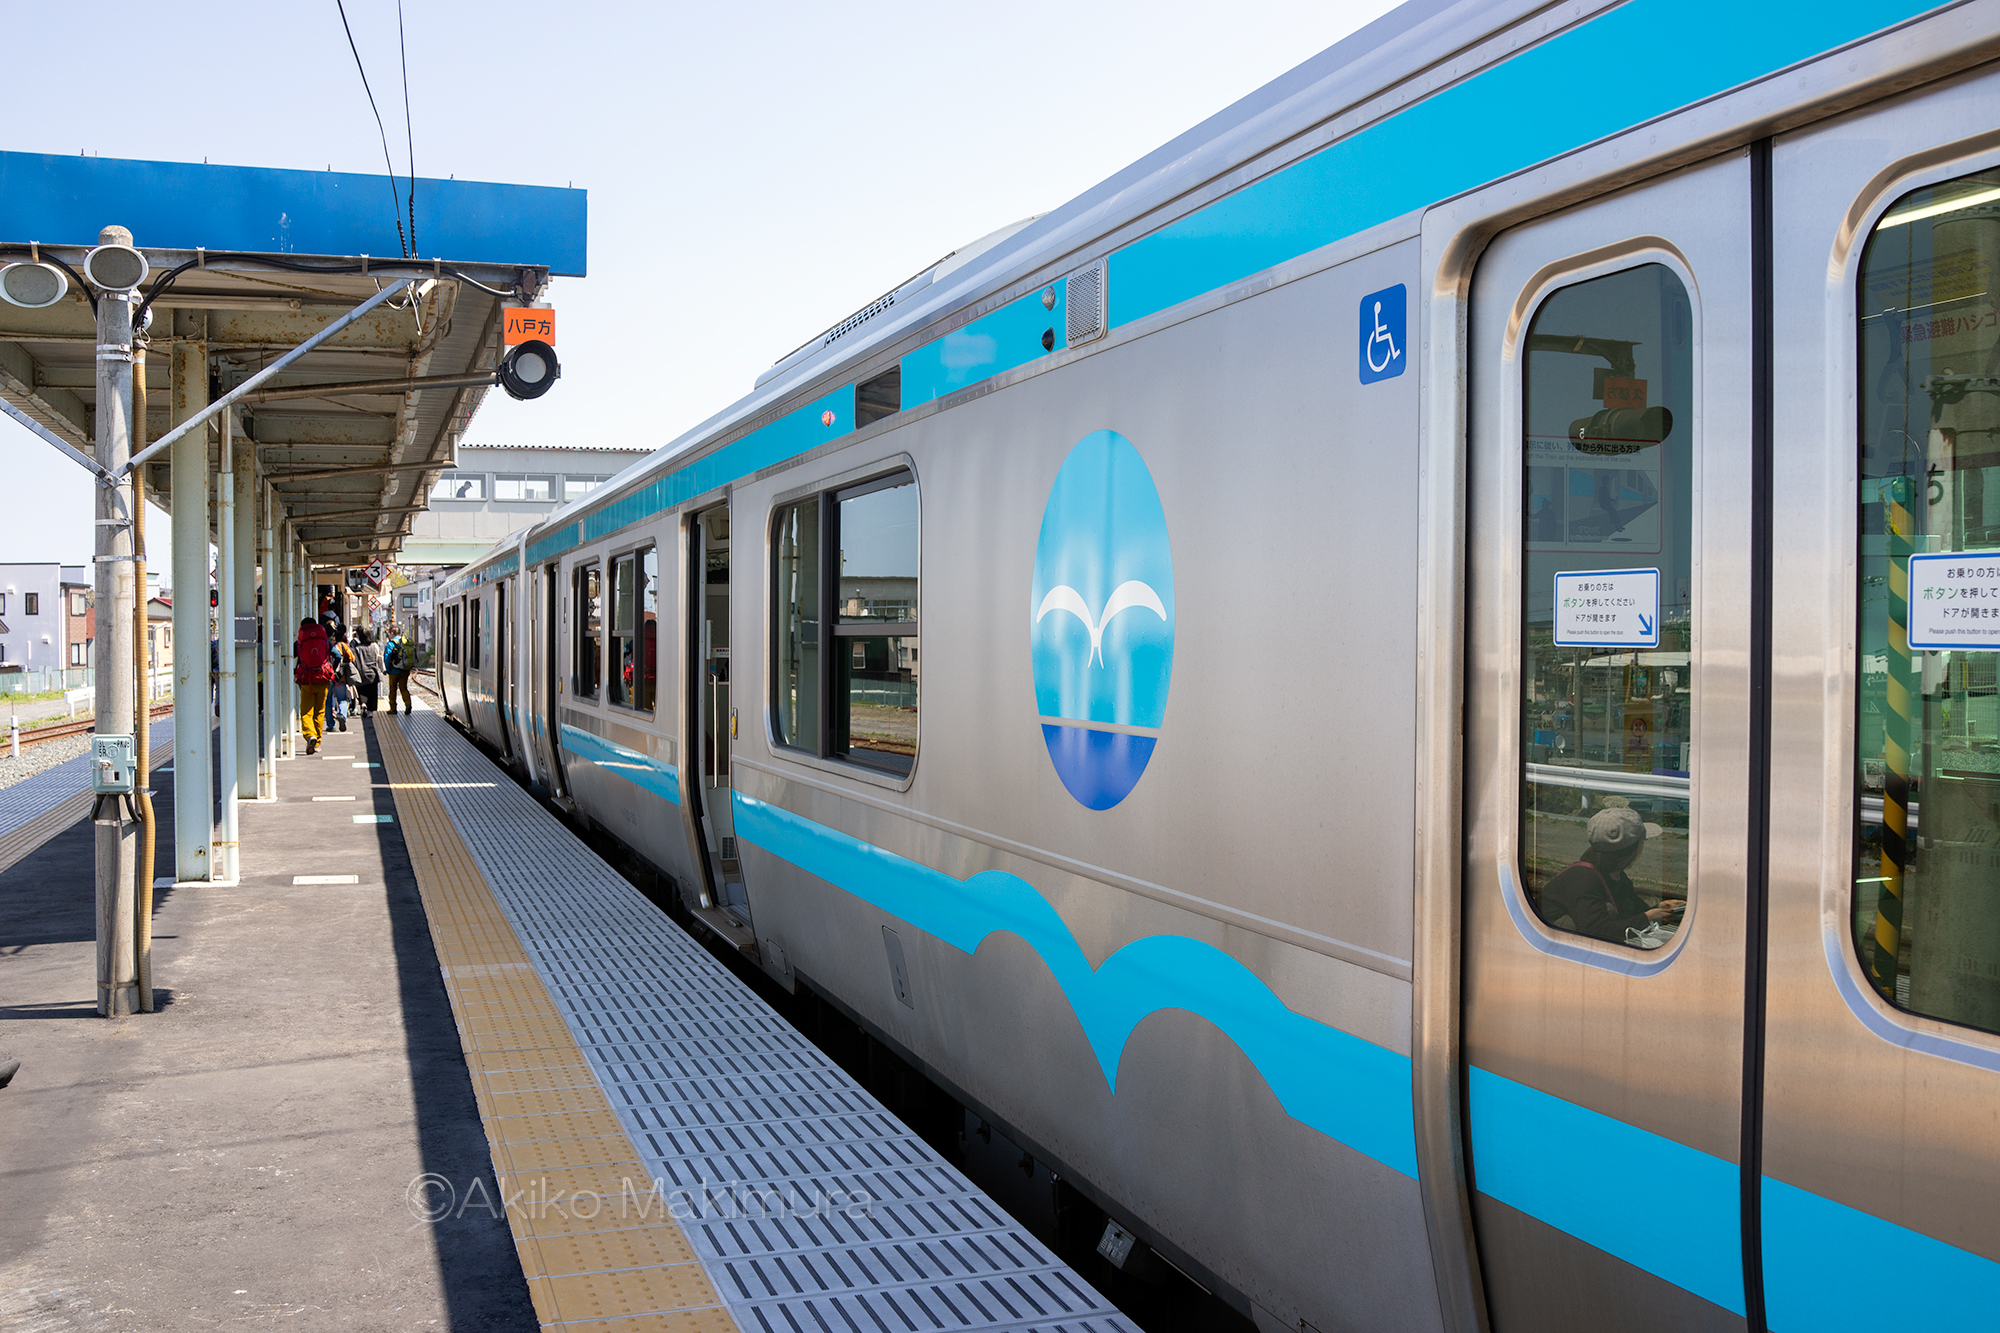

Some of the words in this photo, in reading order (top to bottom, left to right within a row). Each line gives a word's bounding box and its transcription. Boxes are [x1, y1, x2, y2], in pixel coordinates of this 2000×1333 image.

[507, 318, 551, 335] 八戸方
[370, 566, 380, 578] 3
[1578, 583, 1614, 591] お乗りの方は
[1923, 586, 1998, 600] ボタンを押して
[1563, 597, 1635, 608] ボタンを押してください
[1575, 613, 1617, 622] ドアが開きます
[1943, 607, 1999, 619] ドアが開きま
[1928, 627, 1944, 635] Please
[1945, 628, 1956, 636] push
